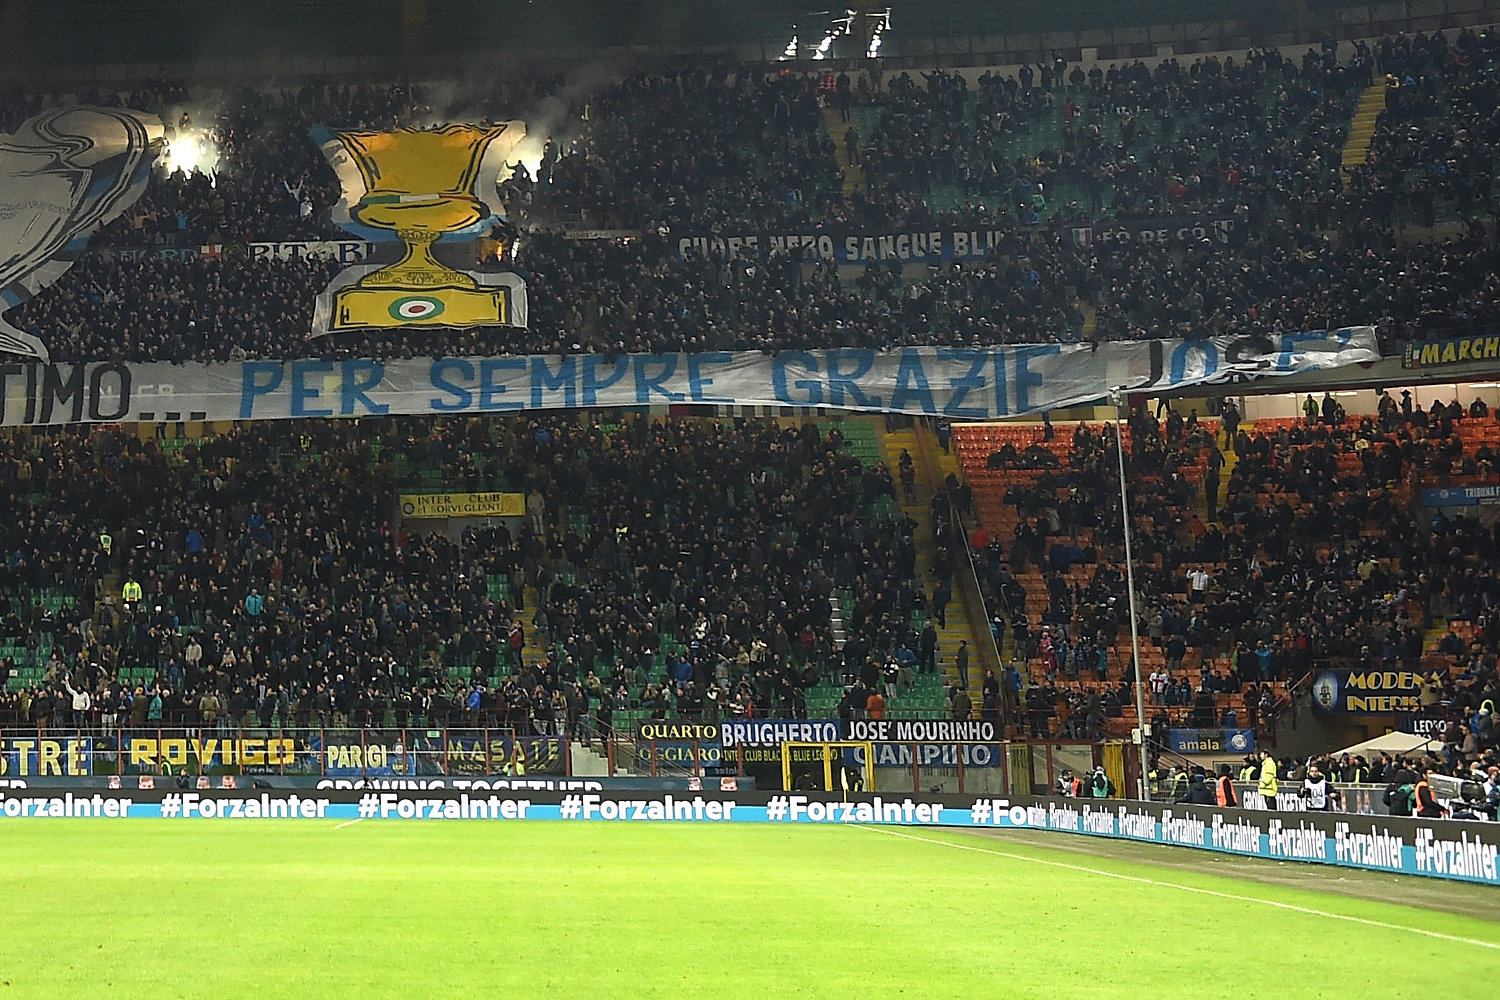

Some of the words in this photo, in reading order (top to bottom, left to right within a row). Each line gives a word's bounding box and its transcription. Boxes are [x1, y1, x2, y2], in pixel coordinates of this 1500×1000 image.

[844, 231, 941, 260] SANGUE
[1420, 337, 1500, 366] MARCH
[241, 360, 388, 419] PER
[430, 353, 734, 413] SEMPRE
[771, 344, 1061, 419] GRAZIE
[418, 496, 451, 505] INTER
[469, 494, 500, 503] CLUB
[641, 724, 717, 740] QUARTO
[897, 721, 994, 740] MOURINHO
[131, 738, 295, 765] ROVIGO
[328, 744, 387, 769] PARIGI
[447, 737, 559, 762] MASATE
[854, 744, 991, 765] CIAMPINO
[1179, 739, 1220, 751] amala
[160, 792, 330, 818] #ForzaInter
[357, 793, 531, 819] #ForzaInter
[559, 794, 736, 820] #ForzaInter
[766, 795, 944, 823] #ForzaInter
[1161, 809, 1205, 845] #ForzaInter
[1211, 813, 1261, 854] #ForzaInter
[1268, 818, 1327, 859] #ForzaInter
[1335, 821, 1403, 869] #ForzaInter
[1414, 827, 1498, 880] #ForzaInter
